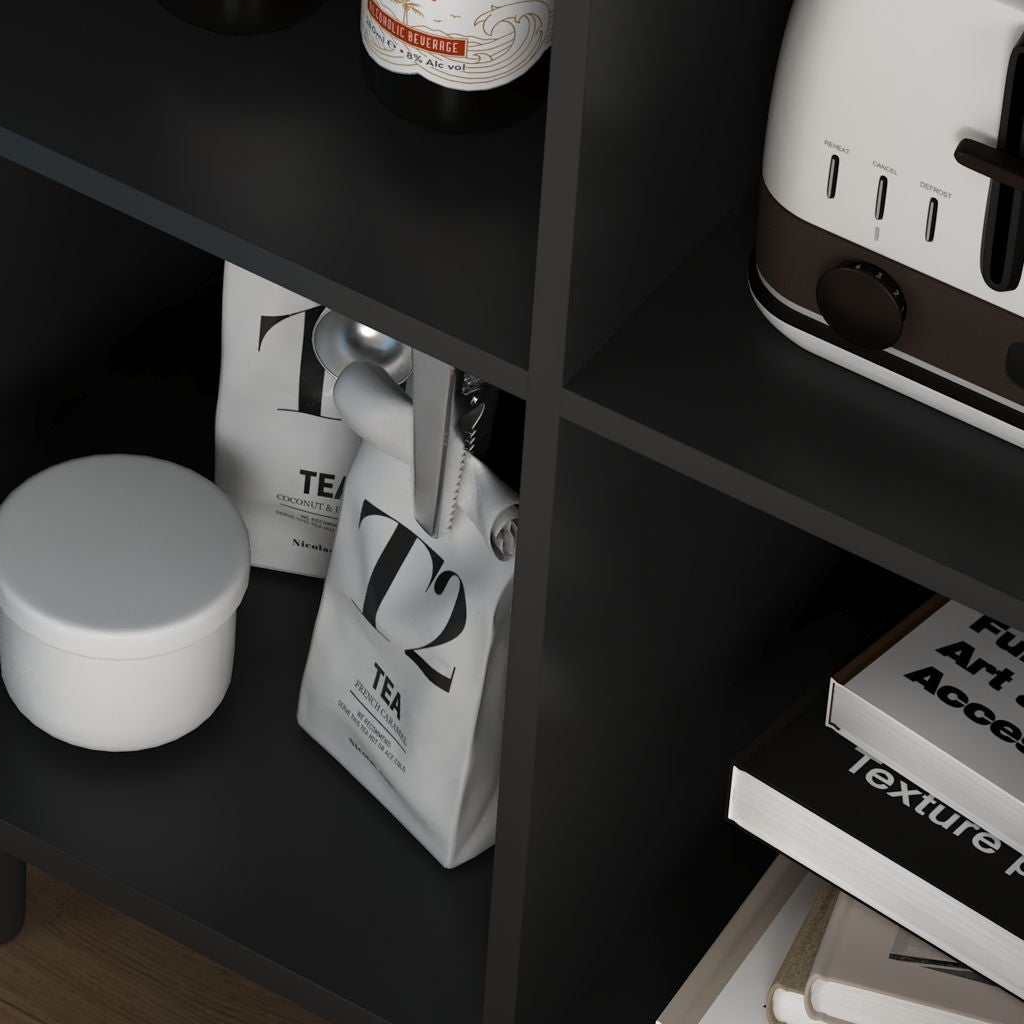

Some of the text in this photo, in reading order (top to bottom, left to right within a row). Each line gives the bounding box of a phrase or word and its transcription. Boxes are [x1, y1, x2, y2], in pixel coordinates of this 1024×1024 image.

[407, 30, 459, 54] BEVERAGE
[406, 51, 423, 64] 8%
[426, 59, 444, 69] Alc
[448, 64, 466, 72] vol
[824, 139, 850, 154] REHEAT
[872, 160, 898, 176] CANCEL
[920, 181, 952, 199] DEFROST
[276, 493, 324, 511] COCONUT
[351, 499, 467, 693] T2
[969, 613, 1024, 664] Fu
[935, 640, 1015, 691] Art
[354, 679, 382, 713] FRENCH
[372, 661, 401, 721] TEA
[847, 745, 1002, 855] Texture
